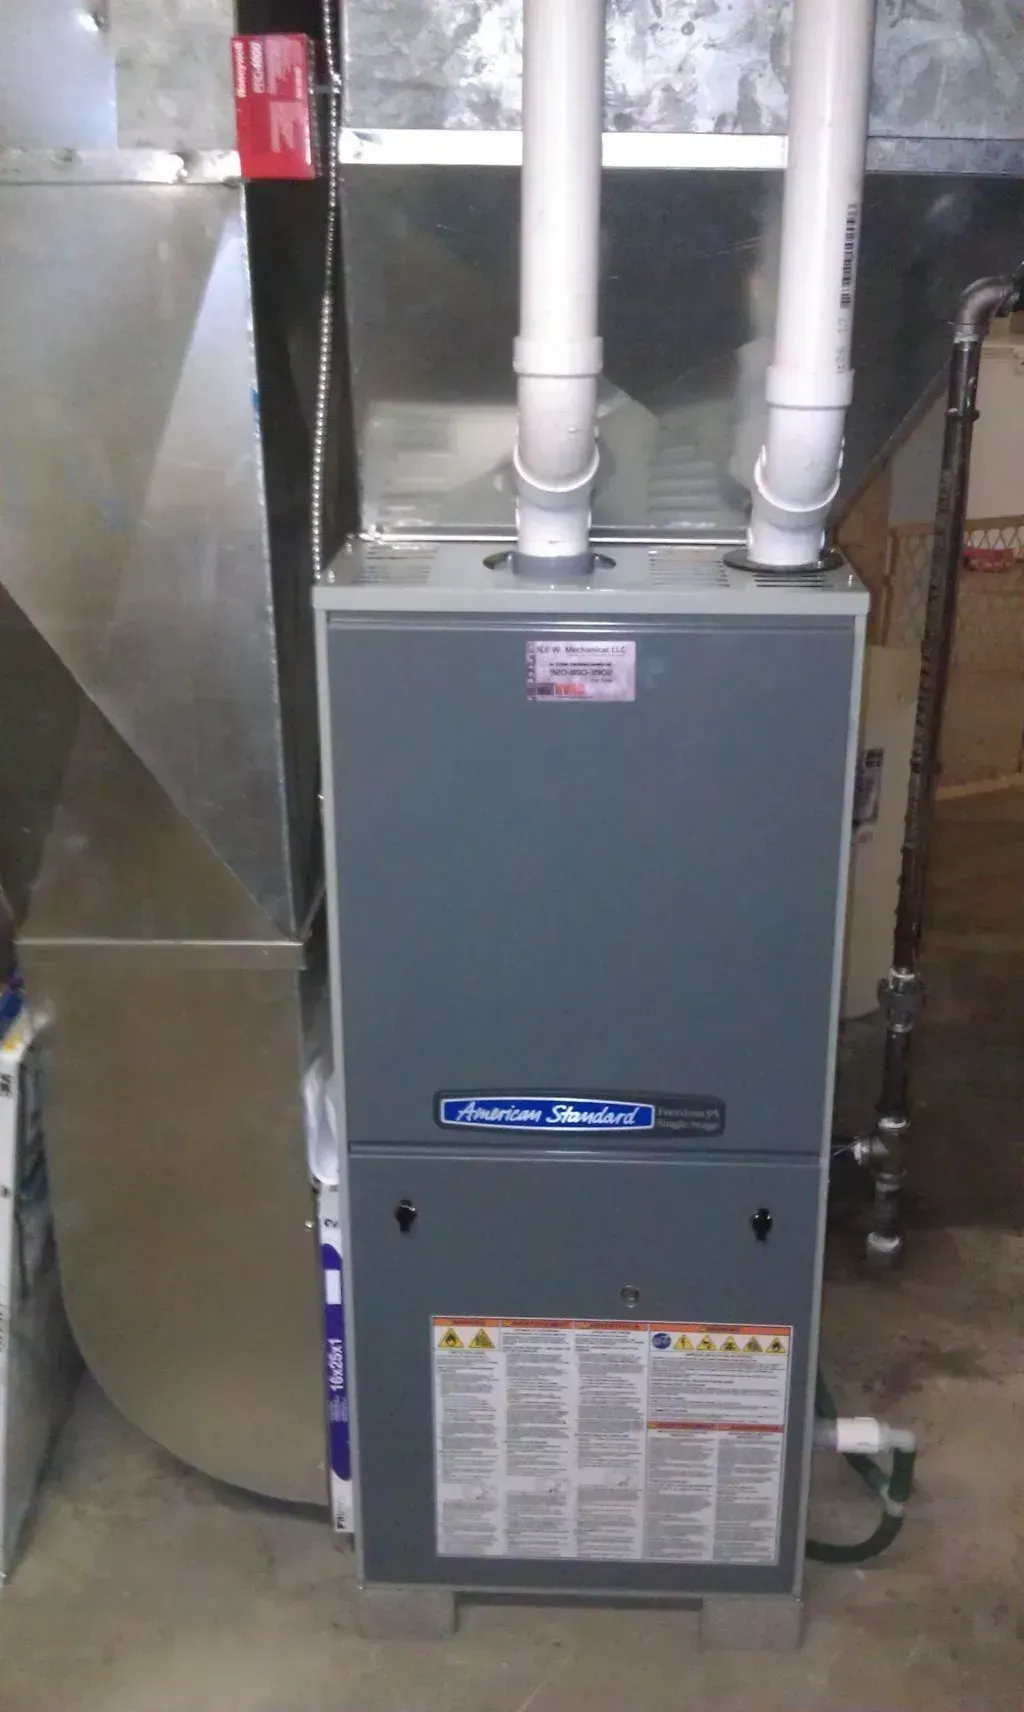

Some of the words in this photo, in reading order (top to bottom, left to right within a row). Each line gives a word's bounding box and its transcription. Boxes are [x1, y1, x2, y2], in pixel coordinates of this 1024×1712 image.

[564, 645, 609, 653] Mechanical
[611, 645, 626, 654] LLC
[456, 1100, 542, 1123] American
[545, 1103, 639, 1126] Standard
[326, 1338, 345, 1392] 16x25x1
